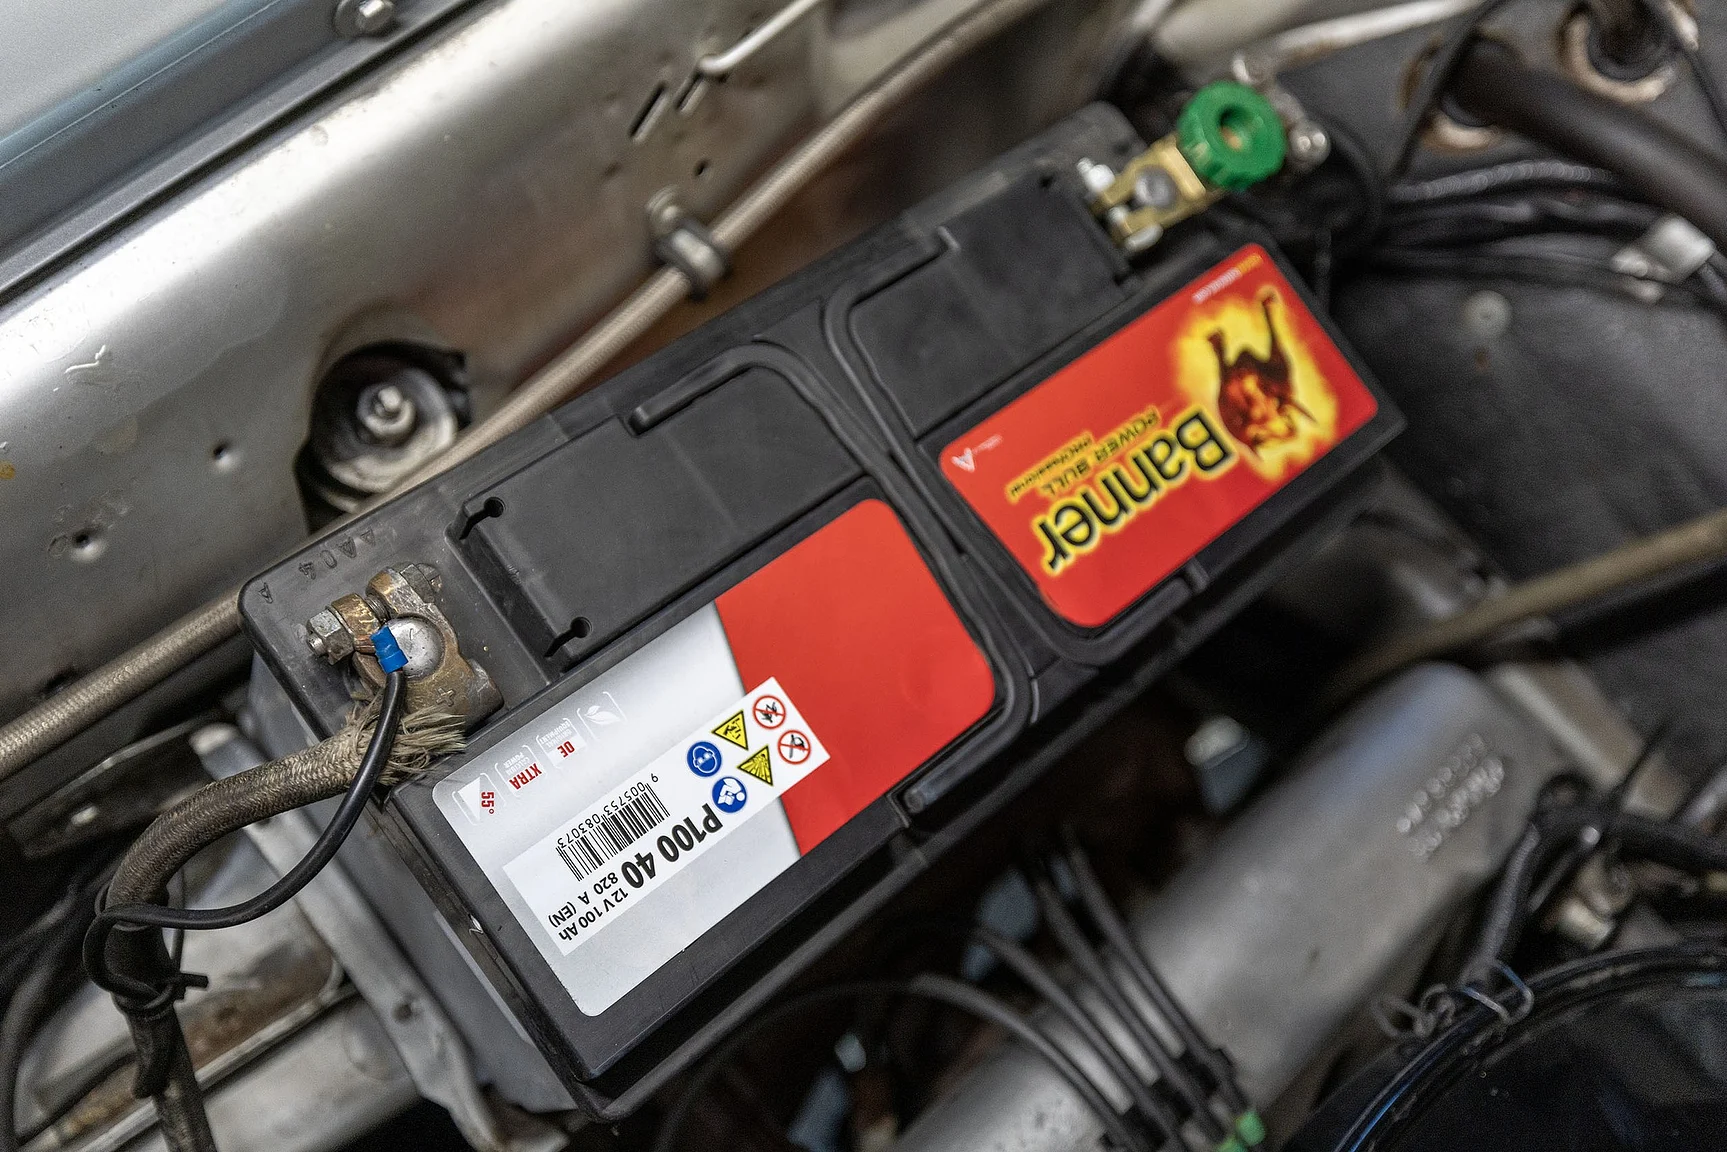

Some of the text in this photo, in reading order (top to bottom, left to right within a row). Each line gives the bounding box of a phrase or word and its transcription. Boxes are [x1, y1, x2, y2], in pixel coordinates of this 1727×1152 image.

[1042, 411, 1158, 495] POWER BULL
[1039, 412, 1231, 569] Banner
[540, 720, 571, 745] EQUIPMENT
[546, 728, 573, 748] ORIGINAL
[503, 751, 525, 768] POWER
[557, 741, 575, 758] OE
[506, 757, 530, 776] CALCIUM
[509, 763, 542, 790] XTRA
[650, 773, 659, 783] 9
[621, 803, 724, 889] P100 40
[548, 872, 619, 928] 820 A (EN)
[578, 906, 603, 928] 100
[558, 922, 579, 941] Ah
